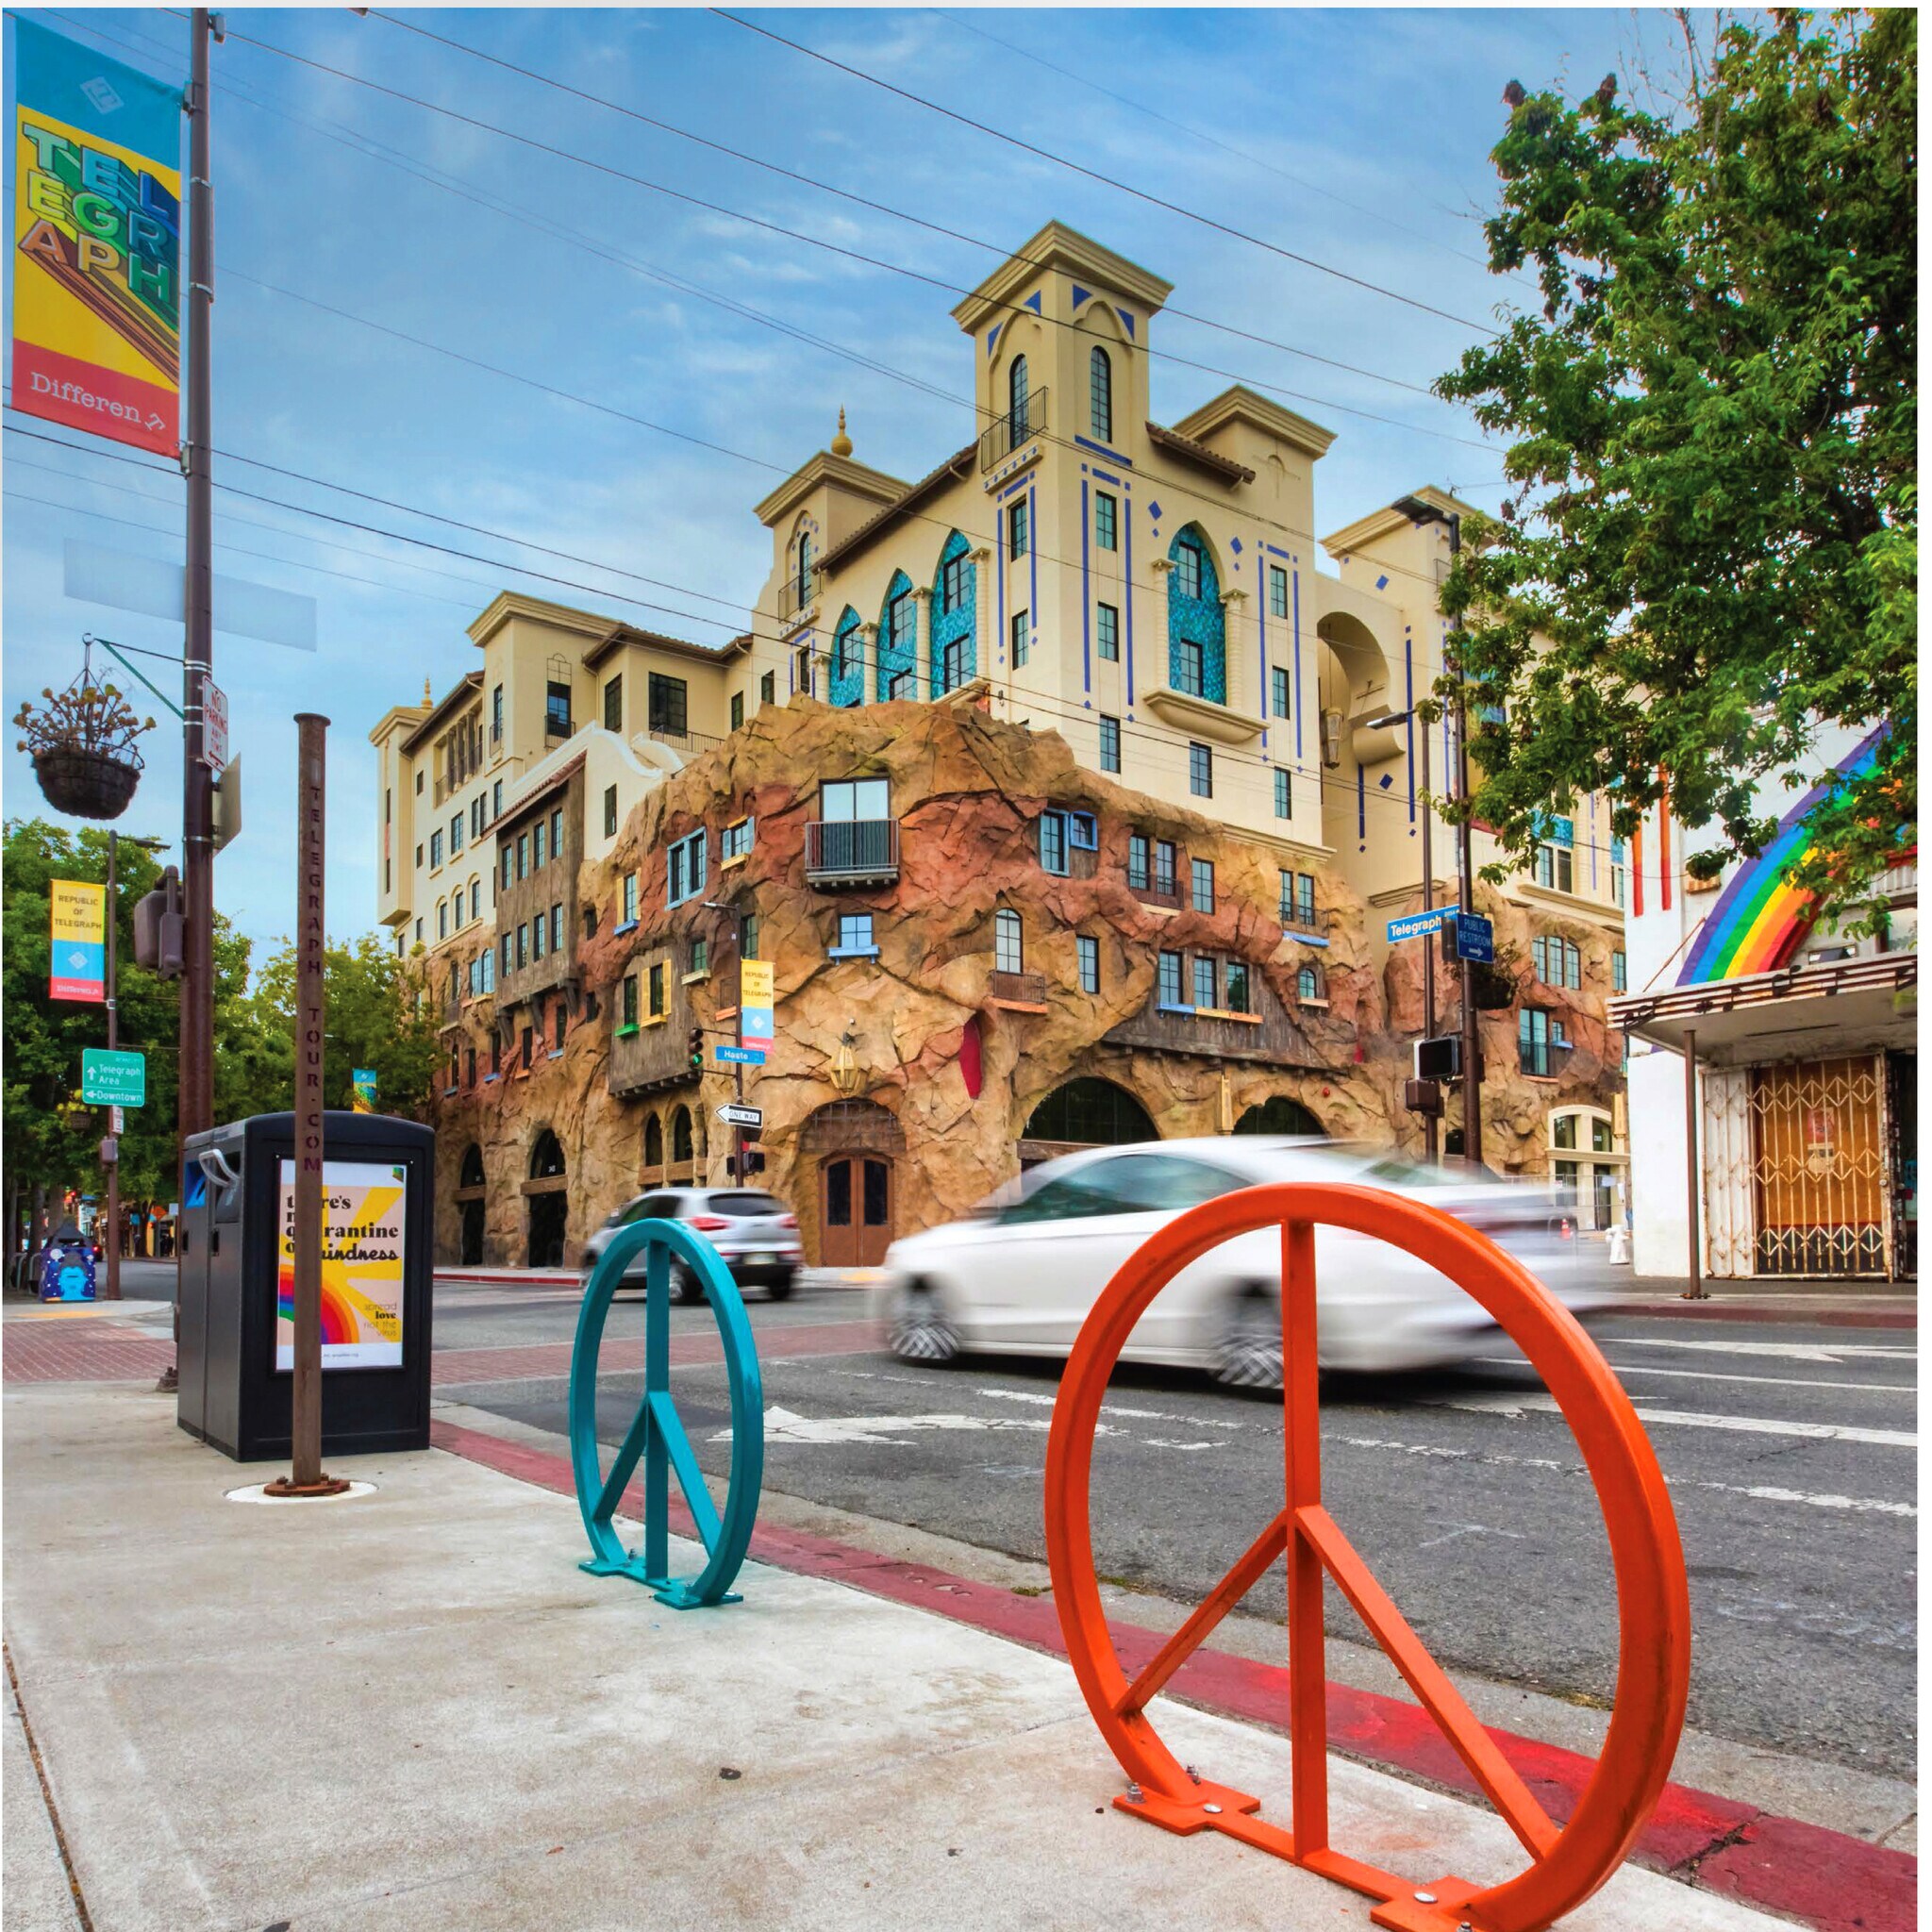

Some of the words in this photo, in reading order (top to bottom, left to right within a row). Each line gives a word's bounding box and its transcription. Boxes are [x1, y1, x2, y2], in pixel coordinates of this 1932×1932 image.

[210, 691, 222, 712] NO
[205, 703, 227, 735] PARKING
[308, 786, 321, 975] TELEGRAPH
[58, 894, 99, 907] REPUBLIC
[73, 908, 84, 916] OF
[55, 918, 103, 929] TELEGRAPH
[1391, 915, 1441, 937] Telegraph
[1464, 918, 1486, 933] PUBLIC
[1458, 930, 1492, 948] RESTROOM
[724, 1050, 749, 1060] Haste
[99, 1063, 142, 1077] Telegraph
[99, 1075, 120, 1085] Area
[97, 1090, 142, 1102] Downtown
[729, 1110, 741, 1119] ONE
[286, 1195, 352, 1209] tre's
[286, 1223, 399, 1241] qrantine
